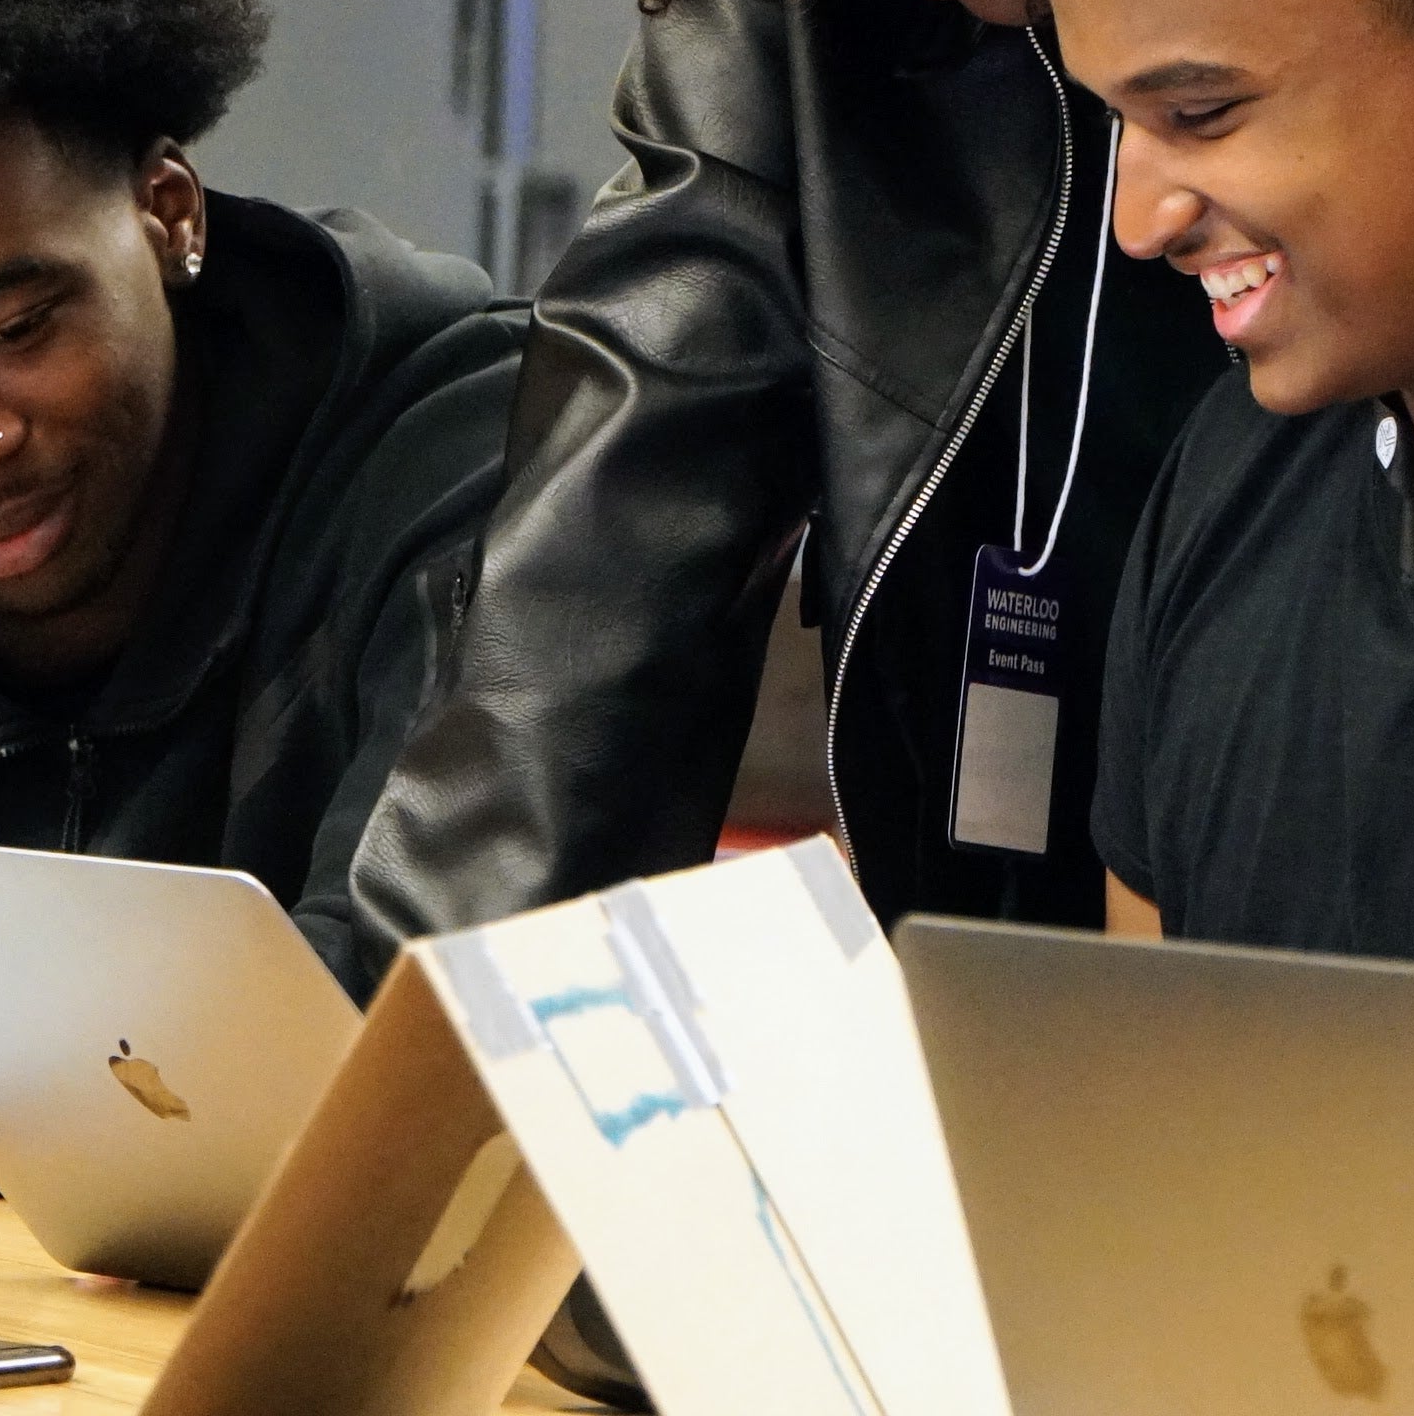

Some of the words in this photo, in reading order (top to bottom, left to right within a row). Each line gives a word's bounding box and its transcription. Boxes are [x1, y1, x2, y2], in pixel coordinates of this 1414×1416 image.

[987, 587, 1059, 621] WATERLOO
[985, 613, 1057, 640] ENGINEERING
[988, 648, 1018, 670] Event
[1020, 654, 1045, 675] Pass
